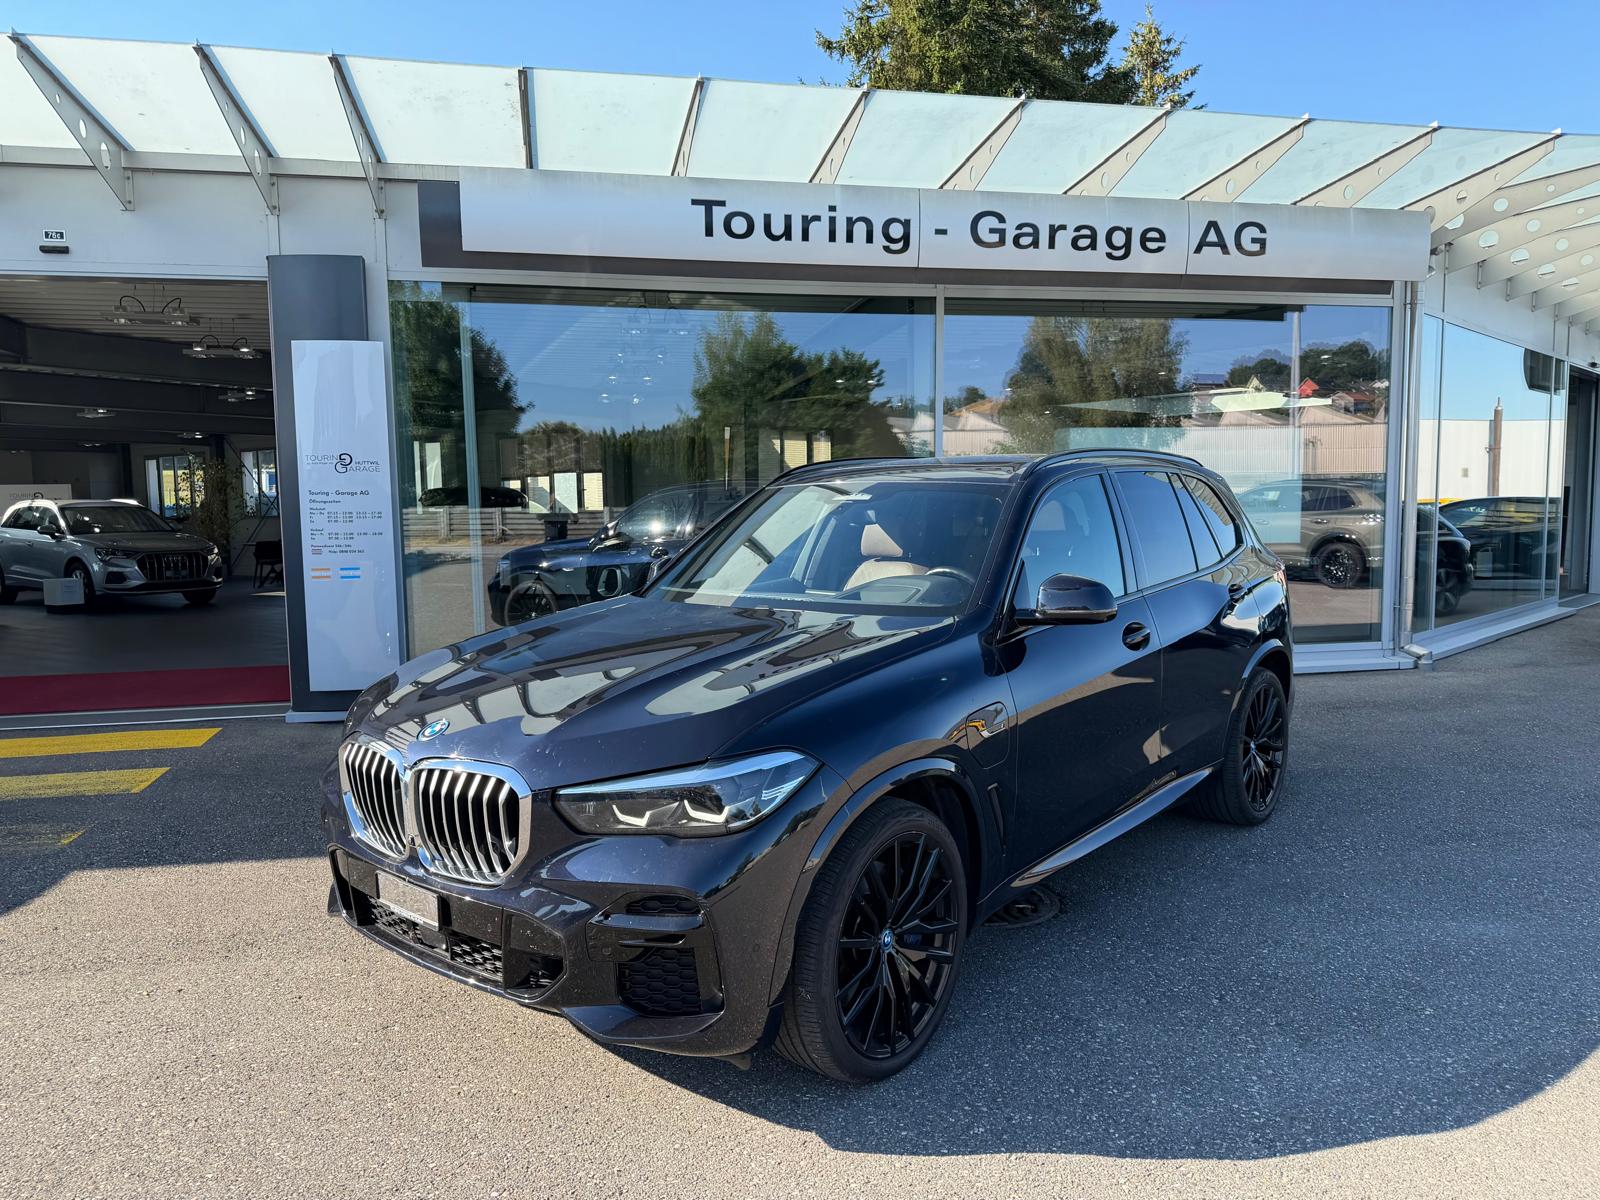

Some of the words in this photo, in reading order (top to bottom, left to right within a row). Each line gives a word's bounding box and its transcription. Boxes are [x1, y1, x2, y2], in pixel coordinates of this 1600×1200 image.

[691, 198, 911, 254] Touring
[970, 210, 1167, 260] Garage
[1193, 220, 1268, 256] AG
